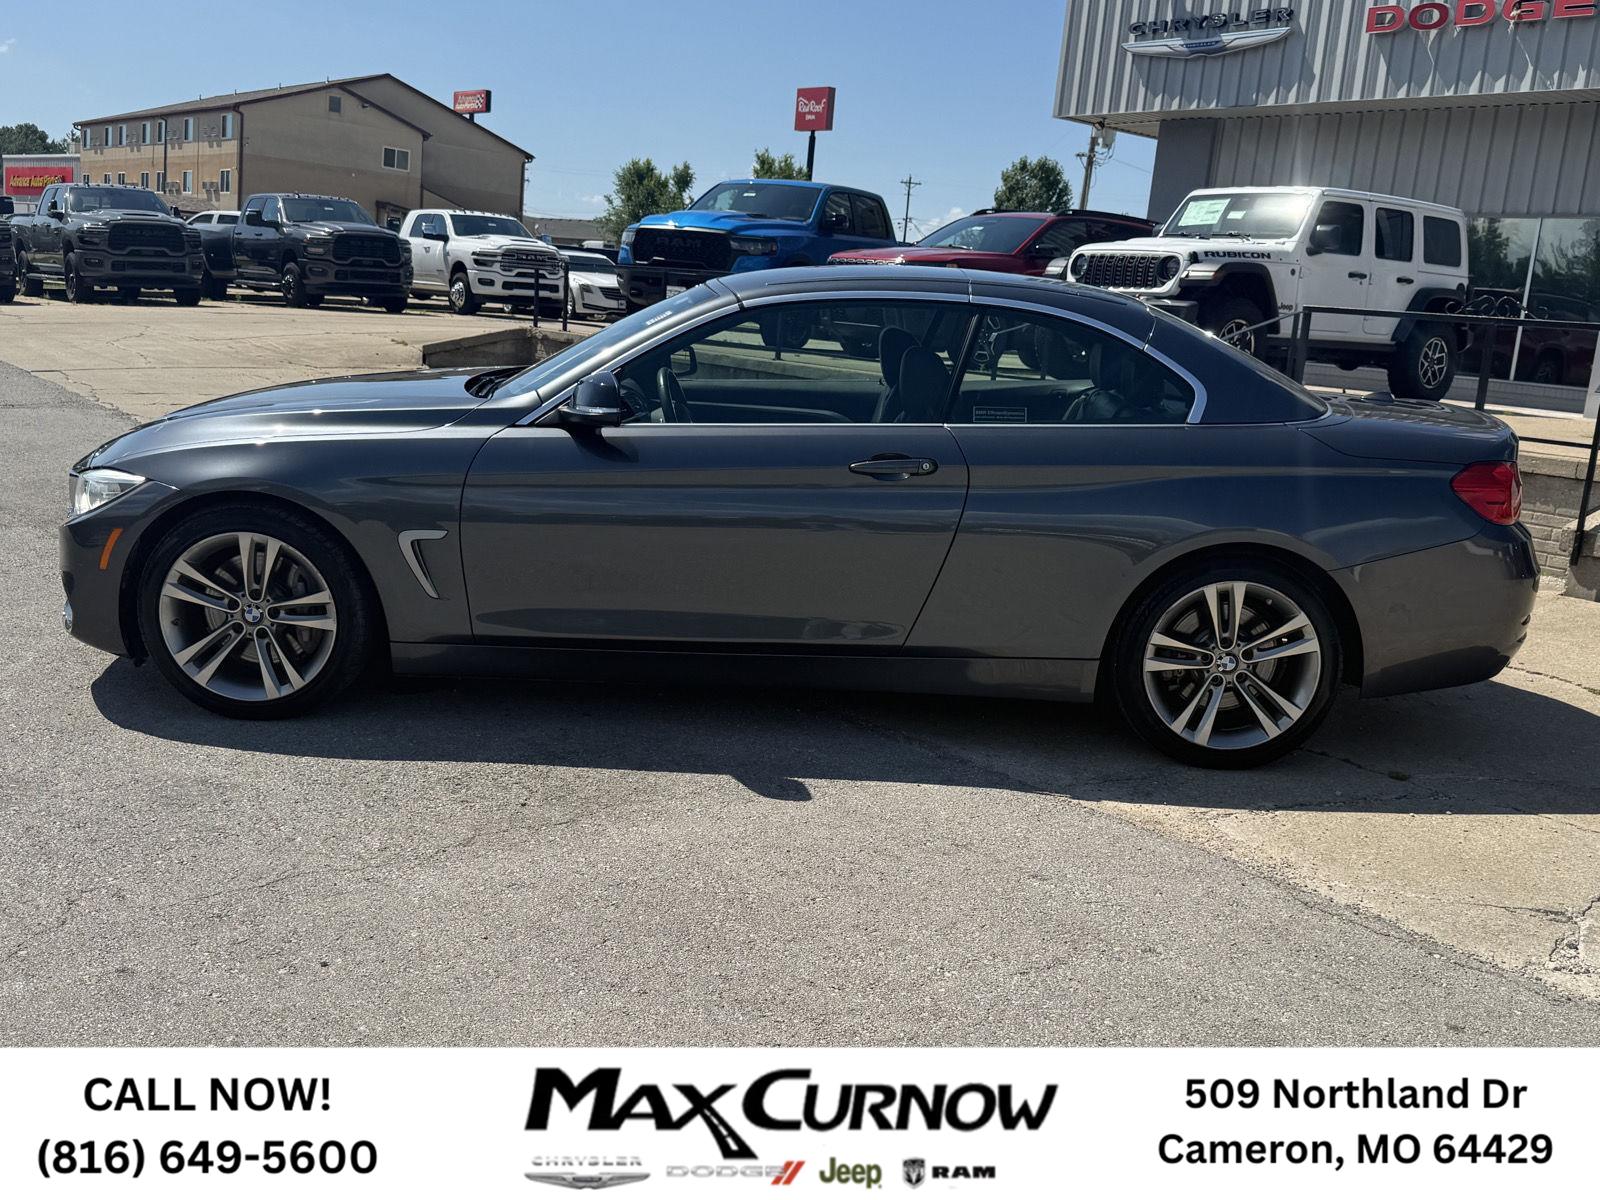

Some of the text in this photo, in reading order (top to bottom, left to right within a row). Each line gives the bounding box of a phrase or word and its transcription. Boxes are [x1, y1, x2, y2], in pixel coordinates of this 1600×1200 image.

[1128, 7, 1293, 35] CHRYSLER
[1366, 0, 1599, 33] DODGE
[1203, 250, 1271, 259] RUBICON
[1279, 302, 1293, 311] Jeep
